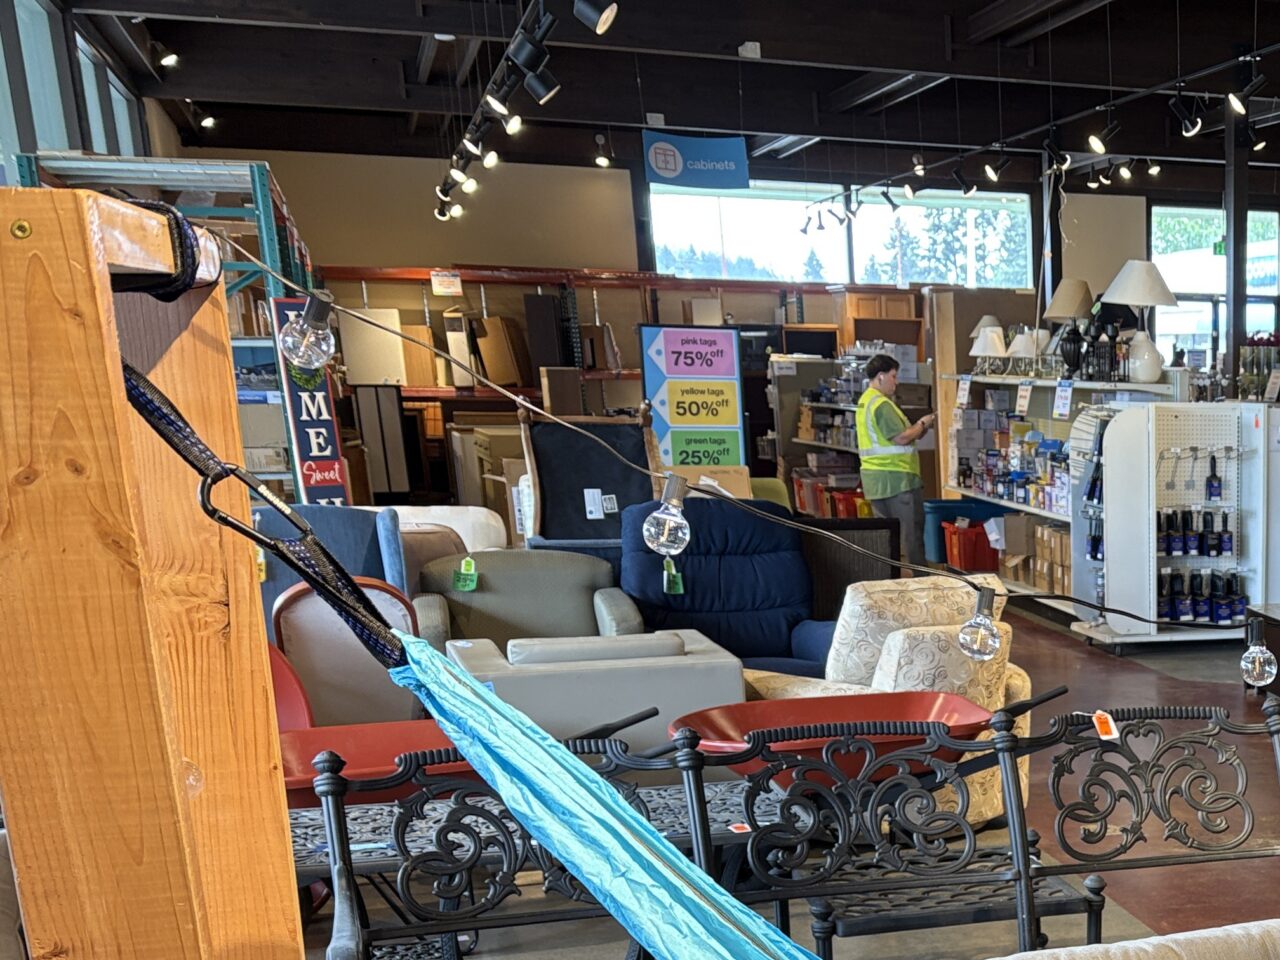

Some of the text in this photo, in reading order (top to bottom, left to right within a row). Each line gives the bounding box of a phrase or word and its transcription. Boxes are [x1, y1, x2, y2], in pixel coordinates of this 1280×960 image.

[686, 159, 736, 171] cabinets
[680, 338, 717, 347] pink tags
[671, 349, 724, 367] 75% off
[680, 387, 725, 396] yellow tags
[675, 399, 729, 417] 50% off
[685, 437, 726, 446] green tags
[679, 448, 730, 466] 25% off
[303, 460, 342, 484] Sweet
